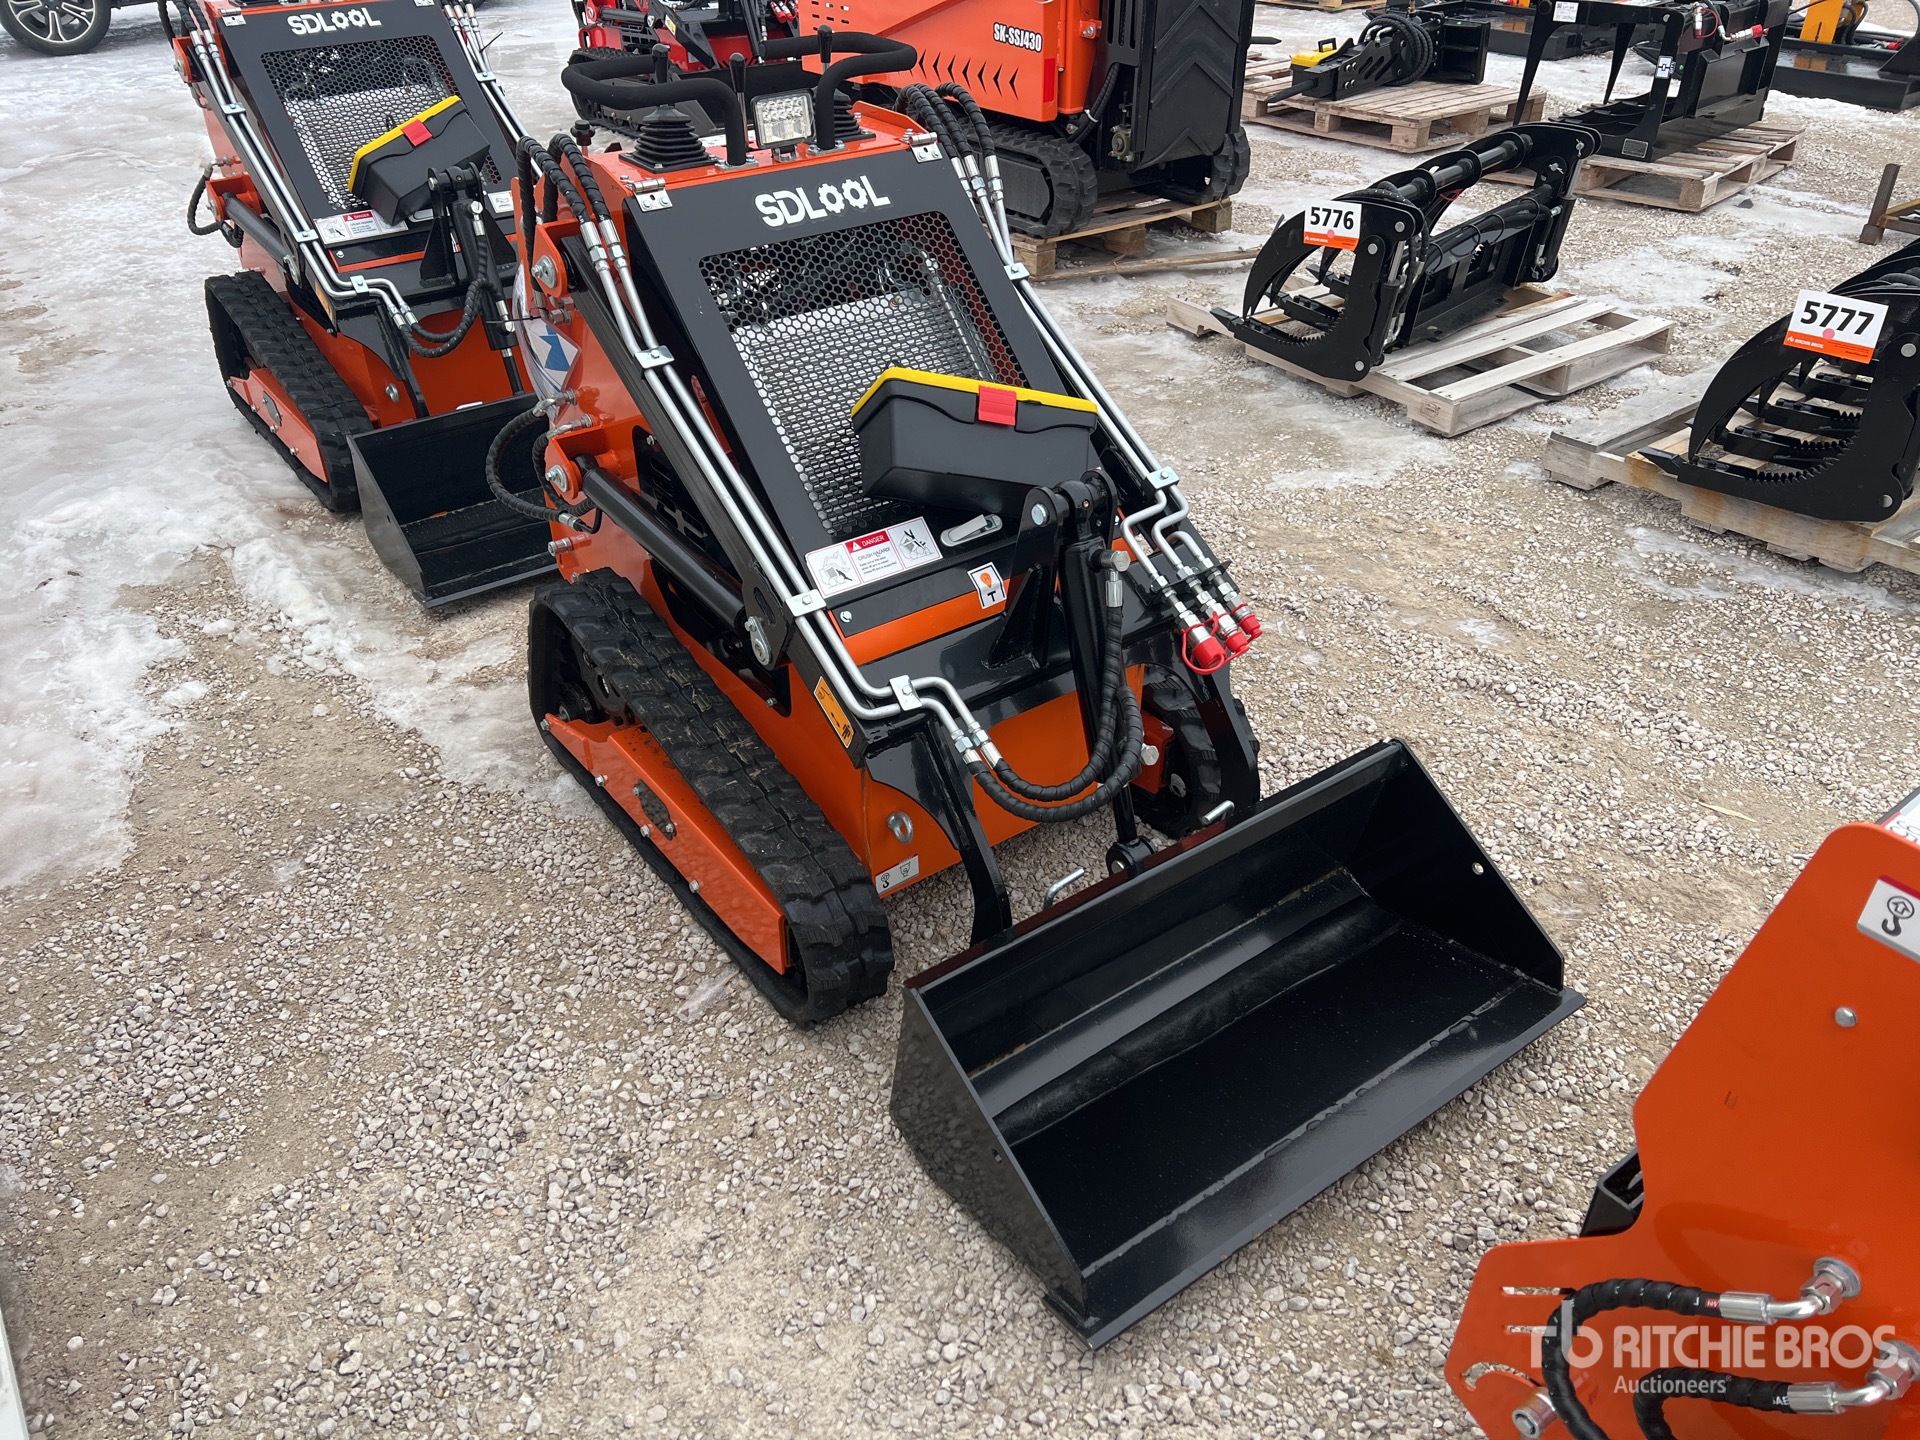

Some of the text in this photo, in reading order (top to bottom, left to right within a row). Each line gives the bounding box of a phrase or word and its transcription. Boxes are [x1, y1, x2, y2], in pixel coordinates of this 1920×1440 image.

[993, 22, 1042, 52] SK-SSJ430
[1310, 206, 1354, 230] 5776
[1800, 300, 1875, 335] 5777
[861, 535, 885, 547] DANGER
